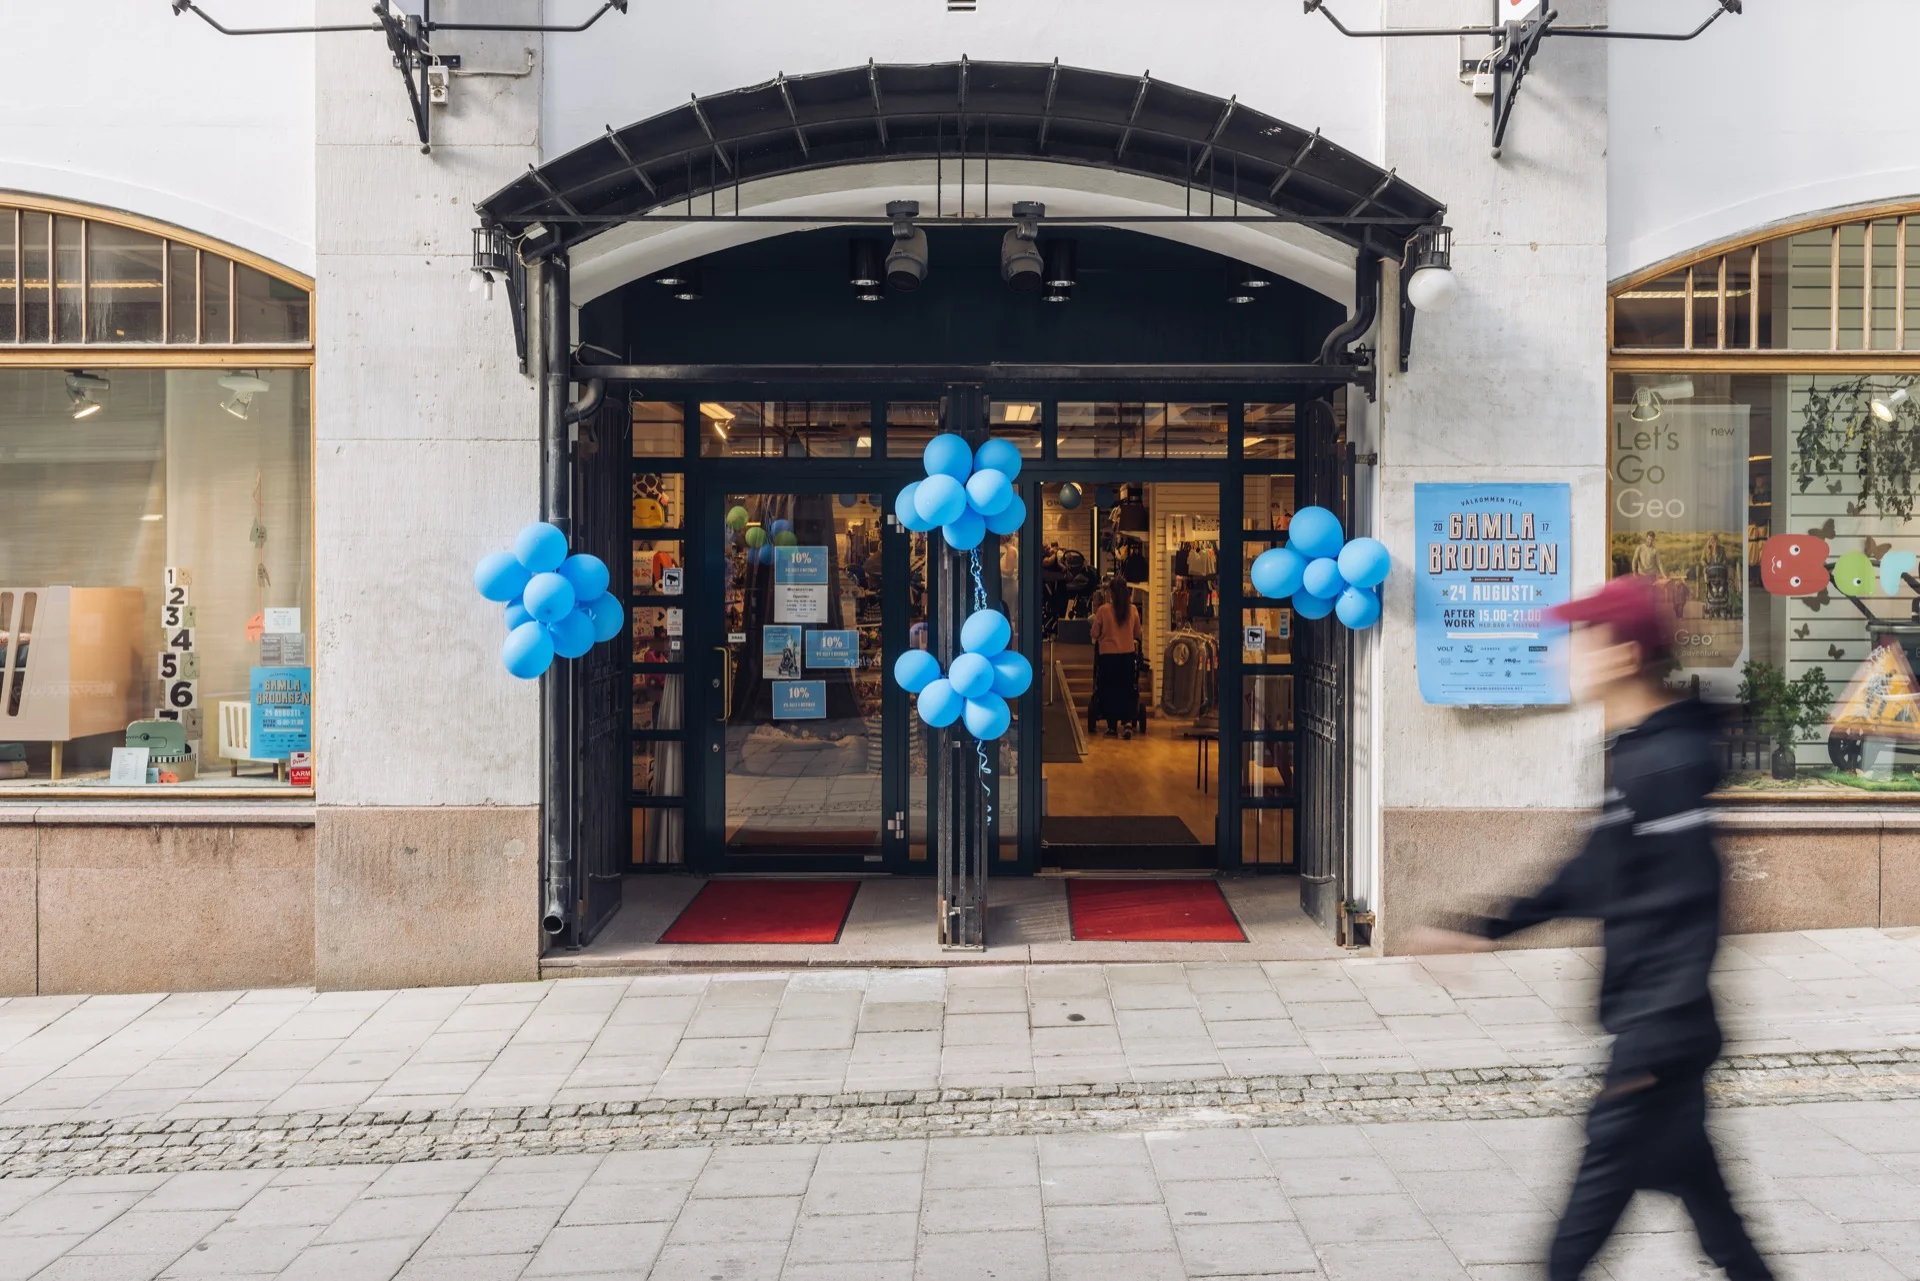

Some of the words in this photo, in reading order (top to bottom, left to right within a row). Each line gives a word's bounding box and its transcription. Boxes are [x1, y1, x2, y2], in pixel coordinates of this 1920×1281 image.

[1616, 422, 1680, 451] Let's
[1711, 426, 1735, 437] new
[1616, 454, 1665, 484] Go
[1508, 498, 1523, 507] TILL
[1616, 488, 1685, 518] Geo
[1433, 522, 1443, 532] 20
[1449, 512, 1536, 541] GAMLA
[1542, 522, 1550, 532] 17
[791, 552, 812, 564] 10%
[1428, 543, 1558, 575] BRODAGEN
[168, 569, 173, 584] 1
[169, 588, 185, 604] 2
[1450, 584, 1467, 601] 24
[1473, 584, 1534, 601] AUGUSTI
[165, 606, 180, 627] 3
[1443, 609, 1475, 618] AFTER
[1479, 609, 1541, 622] 15.00-21.00
[1444, 619, 1475, 628] WORK
[171, 629, 192, 651] 4
[821, 636, 843, 648] 10%
[1681, 648, 1719, 657] adventure
[161, 654, 177, 678] 5
[170, 681, 193, 707] 6
[789, 687, 810, 699] 10%
